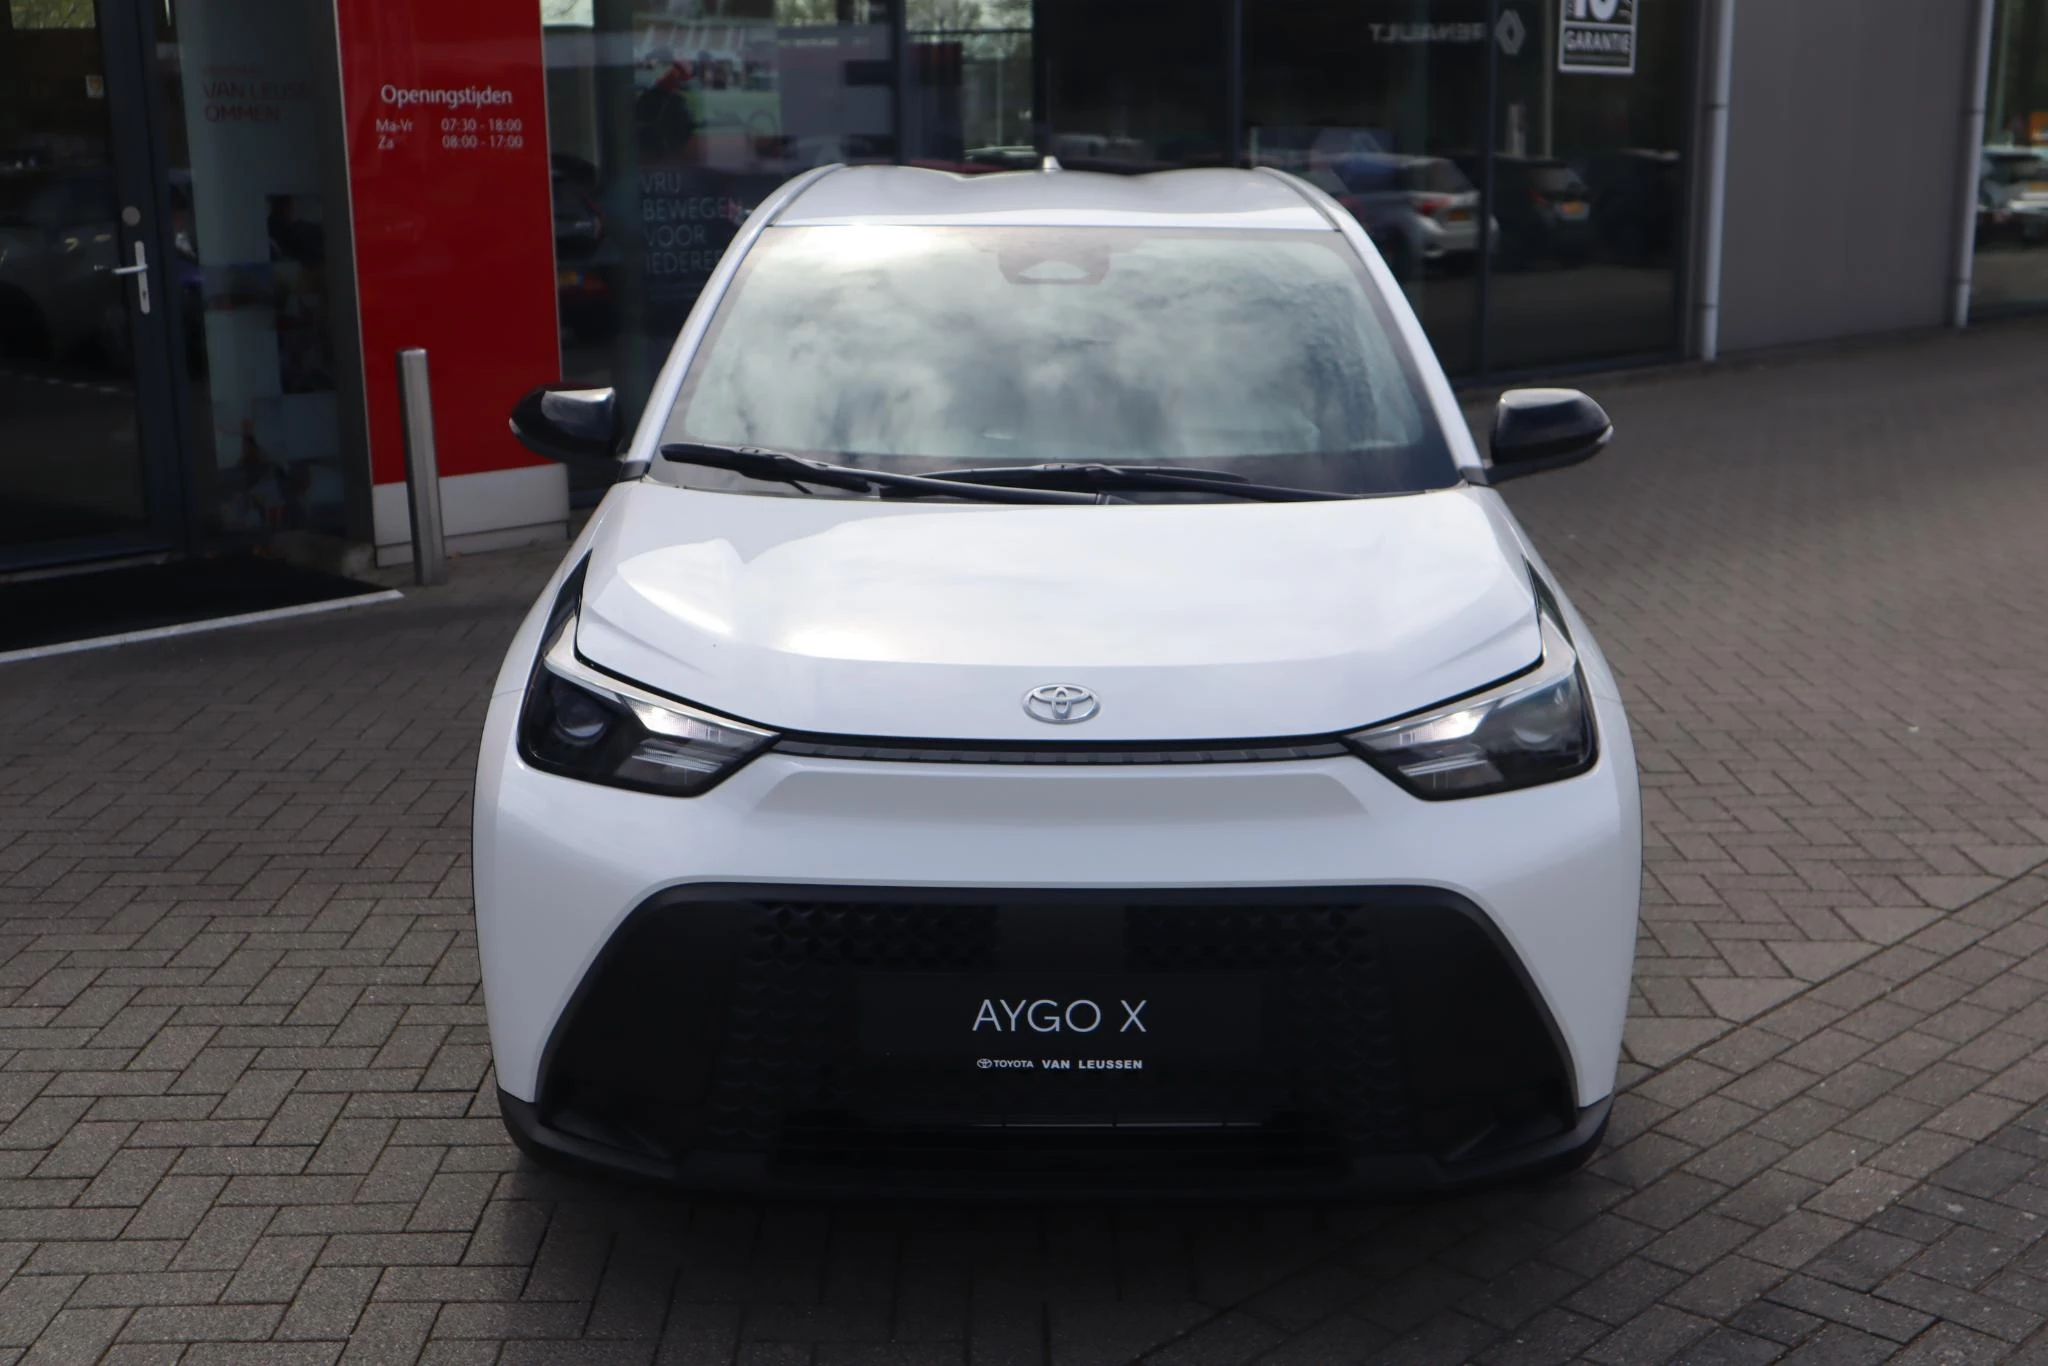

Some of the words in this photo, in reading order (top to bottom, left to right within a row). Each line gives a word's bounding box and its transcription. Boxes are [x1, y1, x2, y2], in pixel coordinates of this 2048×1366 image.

[1566, 30, 1630, 53] GARANTIE
[381, 84, 513, 109] Openingstijden
[375, 118, 413, 133] Ma-Vr
[441, 118, 477, 132] 07:30
[489, 118, 522, 132] 18:00
[377, 135, 395, 150] Za
[442, 135, 477, 149] 08:00
[490, 135, 524, 149] 17:00
[643, 197, 743, 221] BEWEGEN
[645, 224, 707, 247] VOOR
[972, 999, 1101, 1032] AYGO
[1119, 999, 1147, 1032] X
[993, 1059, 1034, 1068] TOYOTA
[1042, 1059, 1070, 1069] VAN
[1078, 1059, 1143, 1069] LEUSSEN
